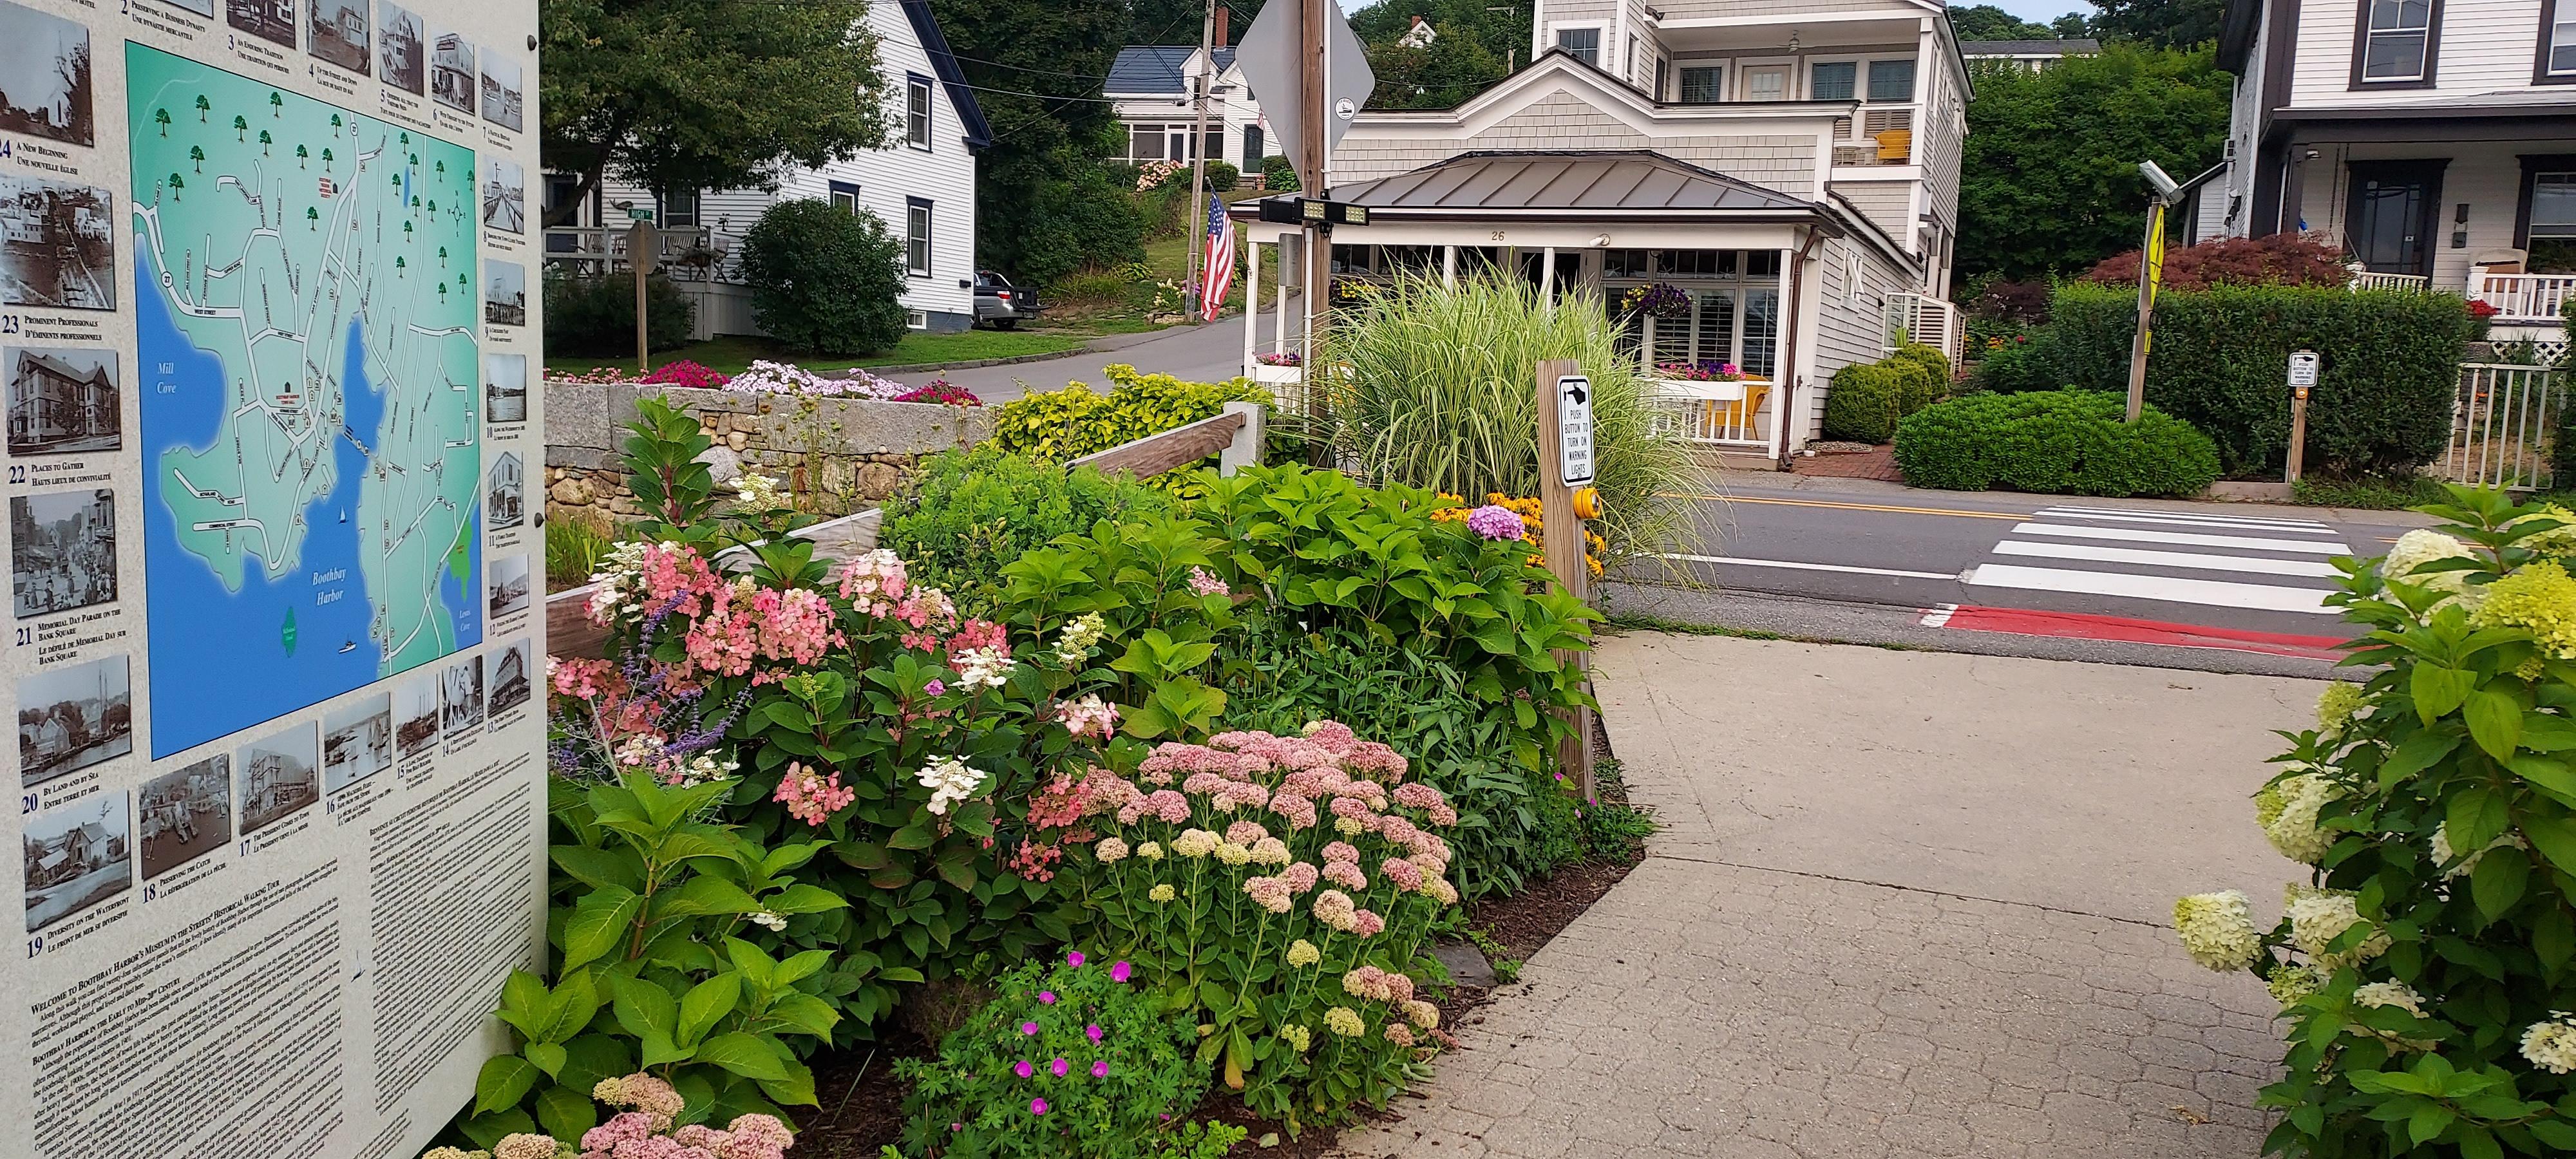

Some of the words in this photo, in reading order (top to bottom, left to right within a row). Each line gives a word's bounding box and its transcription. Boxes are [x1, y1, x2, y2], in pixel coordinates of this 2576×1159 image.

[79, 0, 95, 8] HOTEL
[121, 0, 128, 15] 2
[131, 0, 160, 17] PRESERVING
[166, 12, 185, 26] BUSINESS
[186, 19, 205, 32] DYNASTY
[132, 14, 142, 24] UNE
[144, 19, 165, 31] DYNASTIE
[166, 26, 193, 41] MERCANTILE
[228, 34, 234, 51] 3
[238, 50, 247, 59] UNE
[247, 55, 266, 66] TRADITION
[244, 41, 263, 53] ENDURING
[264, 48, 283, 60] TRADITION
[308, 63, 314, 77] 4
[329, 71, 341, 80] STREET
[348, 77, 357, 86] DOWN
[381, 89, 385, 102] 5
[433, 108, 437, 120] 6
[483, 127, 486, 138] 7
[17, 142, 21, 151] A
[23, 143, 36, 153] NEW
[38, 146, 68, 159] BEGINNING
[17, 156, 30, 166] UNE
[31, 160, 59, 171] NOUVELLE
[61, 165, 78, 175] ÉGLISE
[632, 209, 644, 219] HIGH
[484, 231, 486, 242] 8
[1492, 231, 1504, 241] 26
[2, 315, 19, 334] 23
[24, 316, 57, 325] PROMINENT
[58, 317, 98, 327] PROFESSIONALS
[484, 328, 489, 338] 9
[157, 362, 174, 374] Mill
[156, 381, 176, 393] Cove
[1571, 410, 1582, 419] PUSH
[487, 426, 493, 438] 10
[1565, 424, 1580, 434] BUTTON
[1583, 422, 1588, 432] TO
[1567, 437, 1578, 448] TURN
[1581, 437, 1587, 446] ON
[1569, 450, 1587, 461] WARNING
[8, 465, 25, 484] 22
[32, 464, 52, 473] PLACES
[1571, 464, 1585, 475] LIGHTS
[77, 472, 111, 482] CONVIVIALITÉ
[489, 535, 495, 547] 11
[312, 567, 346, 586] Boothbay
[317, 589, 343, 605] Harbor
[38, 620, 68, 631] MEMORIAL
[82, 613, 102, 622] PARADE
[16, 627, 33, 646] 21
[39, 633, 54, 641] BANK
[55, 628, 76, 638] SQUARE
[489, 625, 495, 636] 12
[48, 642, 66, 653] DÉFILÉ
[75, 636, 104, 647] MEMORIAL
[39, 656, 55, 665] BANK
[56, 651, 77, 661] SQUARE
[488, 722, 493, 734] 13
[442, 744, 449, 757] 14
[397, 764, 404, 780] 15
[53, 783, 68, 793] LAND
[21, 793, 38, 815] 20
[44, 798, 62, 809] ENTRE
[63, 791, 79, 802] TERRE
[88, 785, 99, 793] MER
[327, 798, 335, 815] 16
[262, 825, 280, 838] PRESIDENT
[281, 819, 293, 829] COMES
[299, 811, 309, 820] TOWN
[240, 839, 250, 858] 17
[160, 870, 186, 887] PRESERVING
[187, 865, 195, 874] THE
[196, 858, 211, 869] CATCH
[214, 863, 226, 872] PÊCHE
[143, 883, 155, 904] 18
[48, 922, 75, 939] DIVERSITY
[85, 912, 95, 922] THE
[96, 897, 129, 916] WATERFRONT
[27, 936, 43, 959] 19
[31, 991, 67, 1015] WELCOME
[68, 986, 77, 996] TO
[79, 967, 112, 991] BOOTHBAY
[145, 938, 169, 956] MUSEUM
[171, 934, 176, 943] IN
[178, 928, 188, 938] THE
[214, 900, 243, 919] HISTORICAL
[244, 887, 266, 903] WALKING
[267, 880, 279, 891] TOUR
[48, 945, 55, 953] LE
[57, 936, 74, 948] FRONT
[75, 932, 82, 940] DE
[83, 927, 94, 936] MER
[33, 1042, 64, 1066] BOOTHBAY
[66, 1030, 89, 1047] HARBOR
[97, 1019, 108, 1029] THE
[108, 1008, 126, 1022] EARLY
[158, 977, 180, 994] CENTURY
